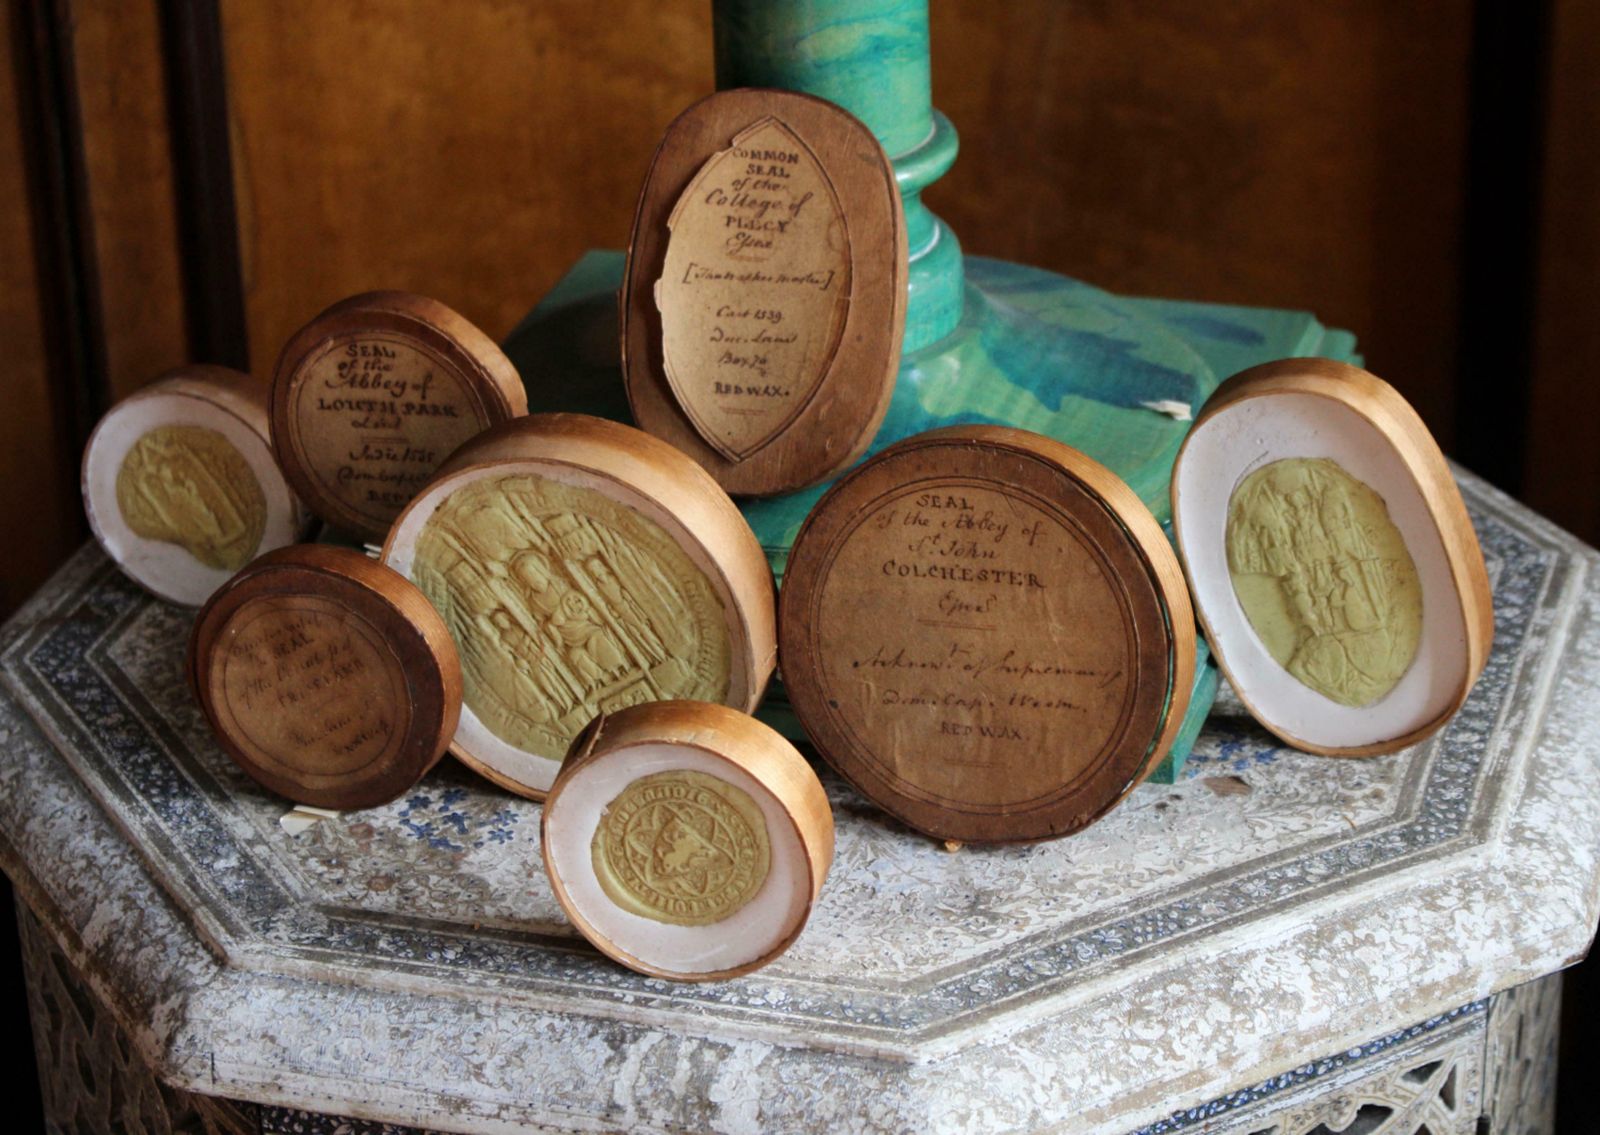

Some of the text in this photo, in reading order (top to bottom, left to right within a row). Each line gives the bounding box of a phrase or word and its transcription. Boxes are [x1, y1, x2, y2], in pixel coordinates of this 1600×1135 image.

[733, 148, 799, 164] COMMON
[746, 164, 791, 178] SEAL
[731, 177, 781, 192] of the
[705, 188, 813, 218] College of
[346, 343, 396, 358] SEAL
[337, 358, 394, 378] of the
[325, 371, 434, 399] Abbey of
[714, 381, 745, 395] RED
[317, 398, 458, 418] LOUTH PARK
[916, 494, 974, 510] SEAL
[876, 511, 1048, 546] of the Abbey of
[940, 540, 998, 560] John
[883, 559, 1047, 588] COLCHESTER
[963, 652, 990, 679] of
[941, 721, 972, 737] RED
